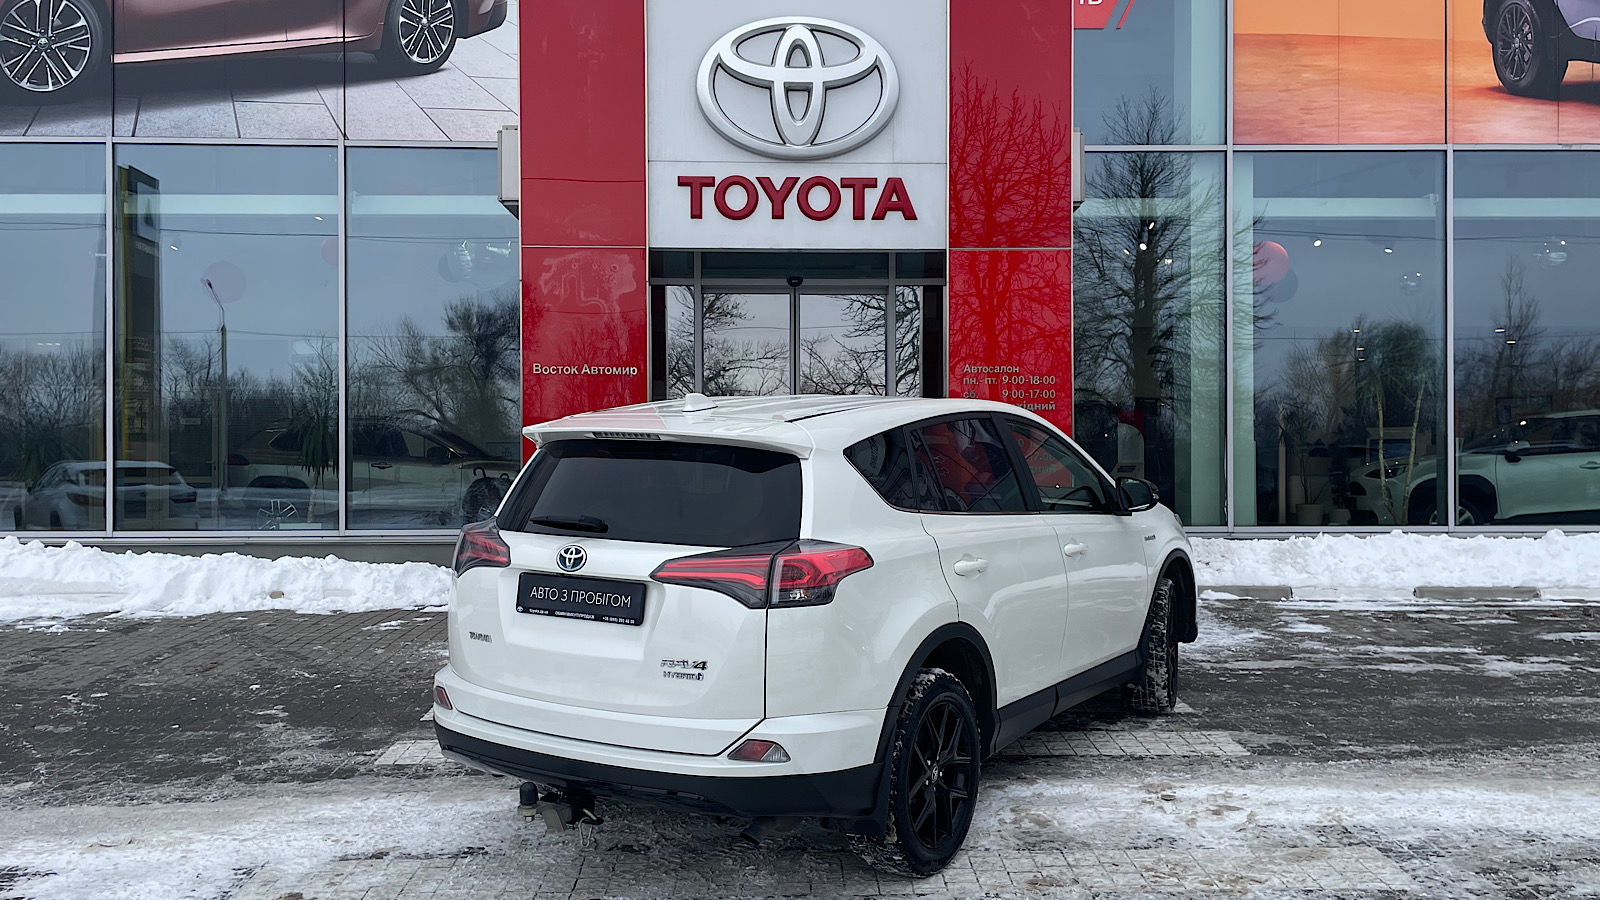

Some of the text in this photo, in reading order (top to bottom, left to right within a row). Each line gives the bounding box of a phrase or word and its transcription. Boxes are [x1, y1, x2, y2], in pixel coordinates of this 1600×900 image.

[677, 175, 918, 221] TOYOTA
[533, 363, 638, 378] Восток Автомир
[963, 364, 1019, 373] Автосалон
[963, 389, 1056, 399] сб. 9:00-17:00
[529, 586, 632, 608] АВТО З ПРОБІГОМ
